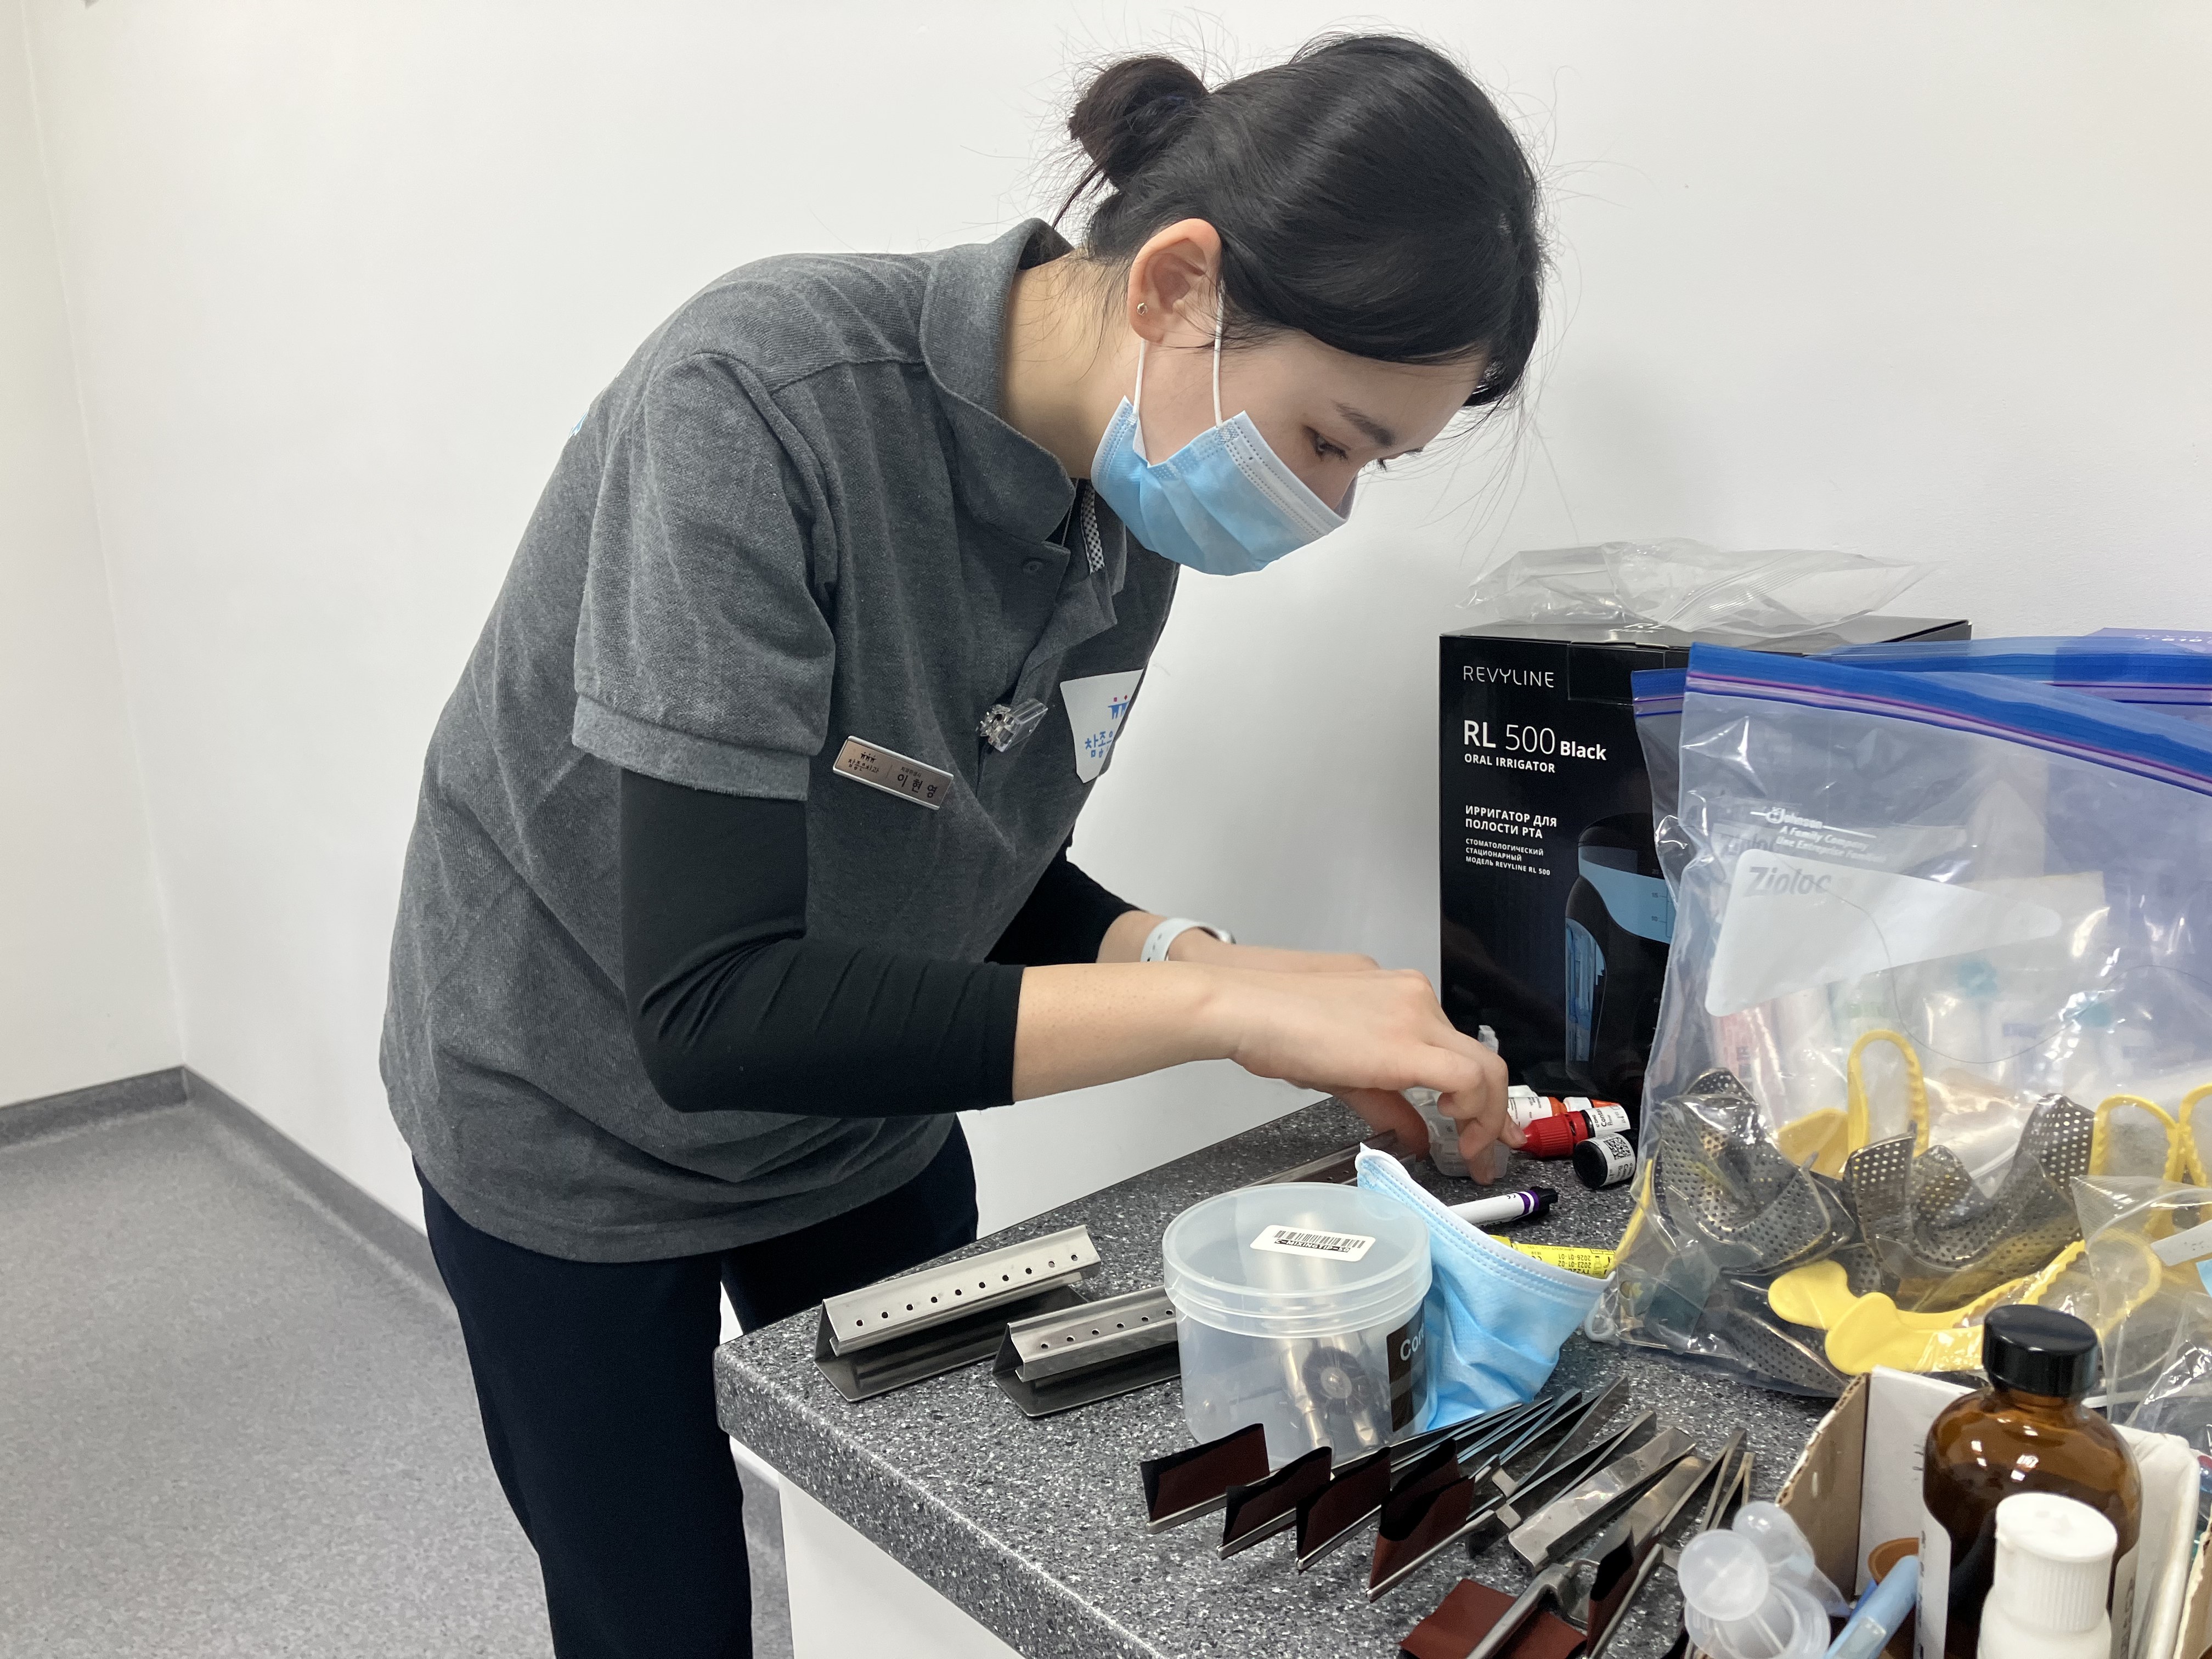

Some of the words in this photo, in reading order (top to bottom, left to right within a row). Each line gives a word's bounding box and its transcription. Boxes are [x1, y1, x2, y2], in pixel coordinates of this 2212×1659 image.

[1463, 665, 1554, 688] REVYLINE
[1464, 720, 1496, 748] RL
[1505, 724, 1555, 754] 500
[1560, 741, 1607, 761] Black
[1464, 753, 1492, 766] ORAL
[1496, 757, 1555, 773] IRRIGATOR
[1465, 805, 1530, 823] ИРРИГАТОР
[1533, 815, 1557, 827] ДЛЯ
[1465, 818, 1519, 835] ПОЛОСТИ
[1522, 826, 1543, 839] РТА
[1465, 838, 1544, 856] СТОМАТОЛОГИЧЕСКИЙ
[1465, 847, 1522, 862] СТАЦИОНАРНЫЙ
[1465, 856, 1493, 866] МОДЕЛЬ
[1495, 861, 1527, 872] REVYLINE
